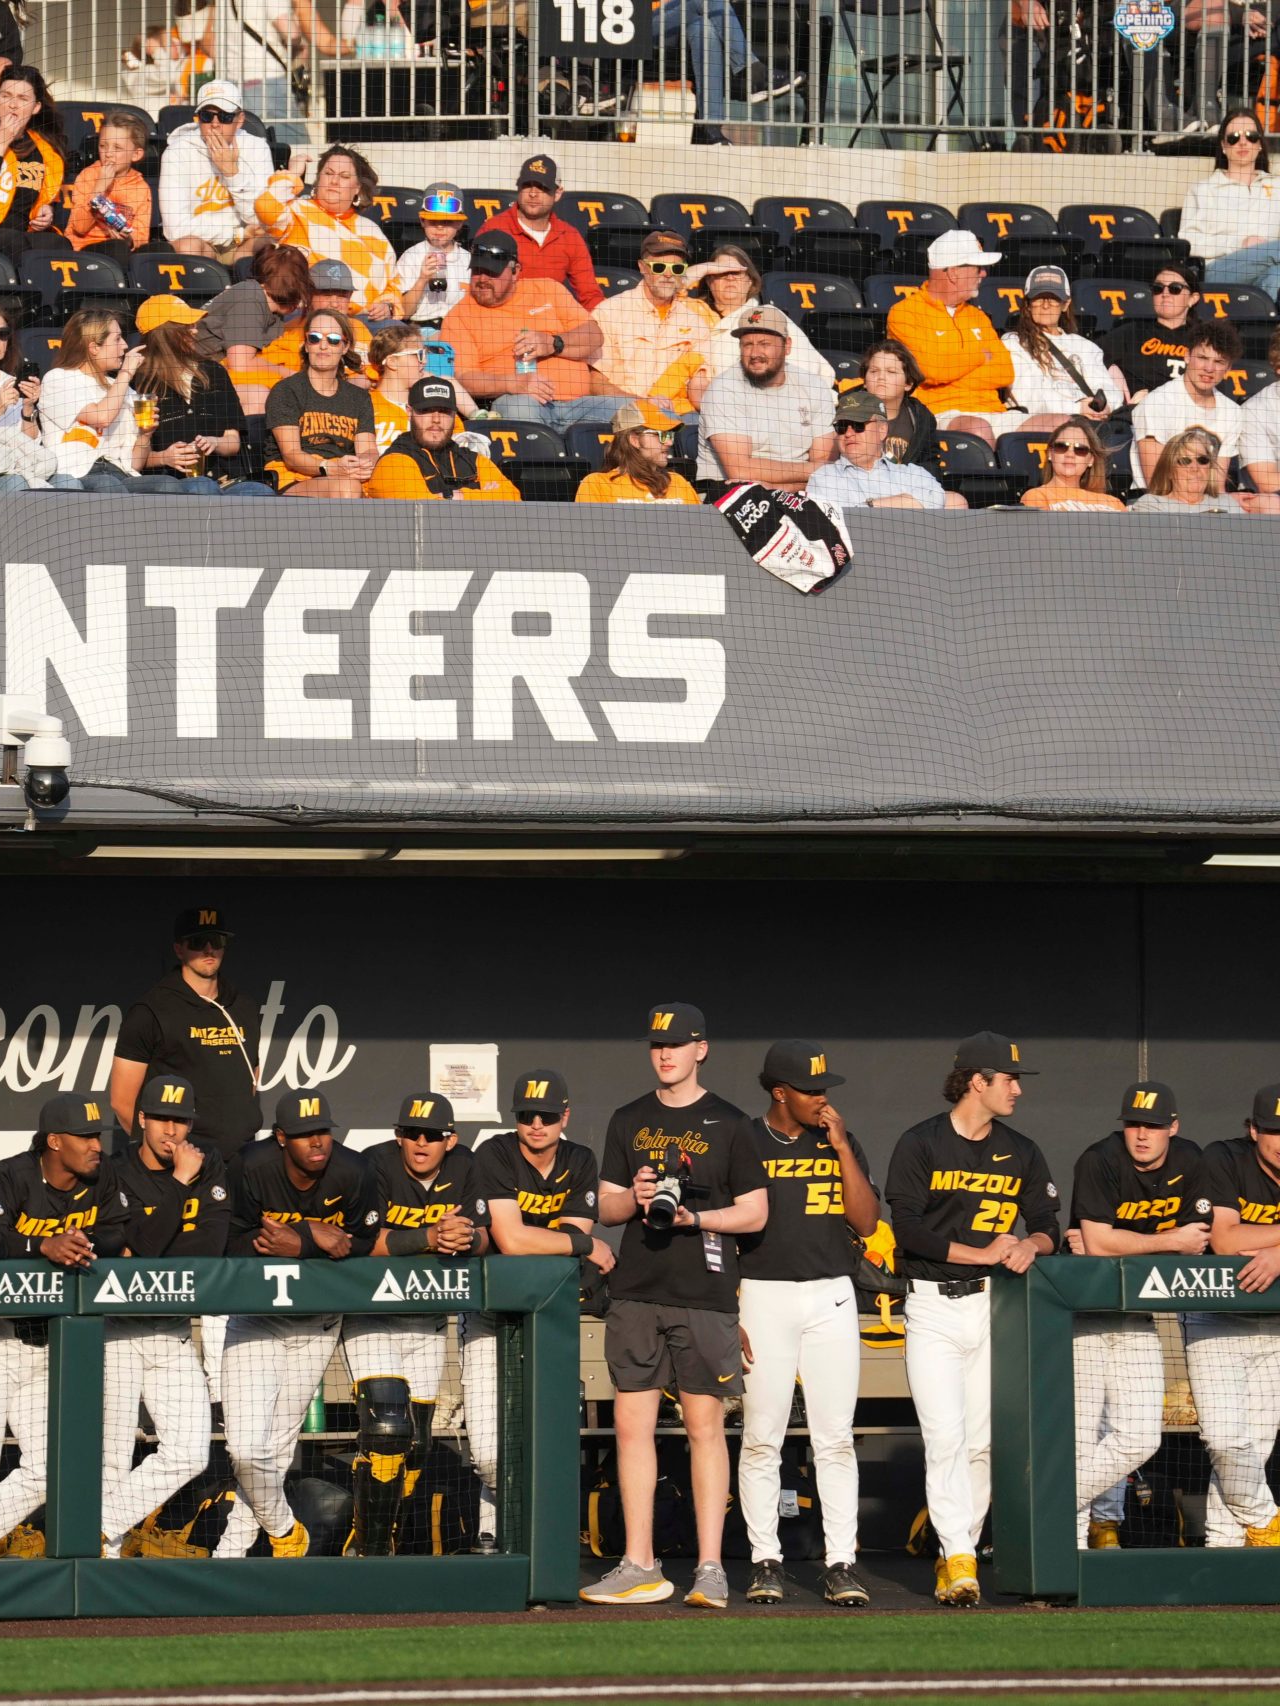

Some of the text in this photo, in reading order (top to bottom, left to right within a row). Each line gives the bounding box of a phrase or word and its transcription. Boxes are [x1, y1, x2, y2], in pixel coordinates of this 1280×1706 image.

[553, 0, 635, 45] 118
[1117, 14, 1171, 25] OPENING
[372, 196, 397, 220] T
[578, 202, 604, 226] T
[680, 204, 706, 229] T
[784, 207, 810, 229] T
[887, 211, 913, 232] T
[987, 213, 1013, 237] T
[1089, 215, 1115, 239] T
[51, 261, 78, 287] T
[159, 265, 185, 290] T
[790, 283, 816, 308] T
[998, 288, 1025, 312] T
[1100, 290, 1126, 315] T
[1203, 293, 1230, 318] T
[1140, 337, 1189, 356] Oma
[1166, 359, 1186, 379] T
[1223, 370, 1248, 395] T
[490, 431, 518, 457] T
[740, 500, 770, 534] Good
[200, 911, 216, 924] M
[652, 1013, 673, 1030] M
[257, 981, 357, 1092] to
[811, 1056, 826, 1075] M
[161, 1087, 184, 1103] M
[525, 1082, 548, 1098] M
[1133, 1091, 1157, 1109] M
[85, 1103, 100, 1121] M
[300, 1100, 320, 1117] M
[409, 1101, 433, 1118] M
[633, 1126, 710, 1155] Columbia
[930, 1170, 1021, 1197] MIZZOU
[971, 1200, 1019, 1233] 29
[128, 1270, 195, 1294] AXLE
[264, 1265, 300, 1306] T
[405, 1268, 470, 1292] AXLE
[1170, 1267, 1235, 1291] AXLE
[129, 1294, 195, 1302] LOGISTICS
[406, 1292, 470, 1300] LOGISTICS
[1172, 1290, 1235, 1298] LOGISTICS
